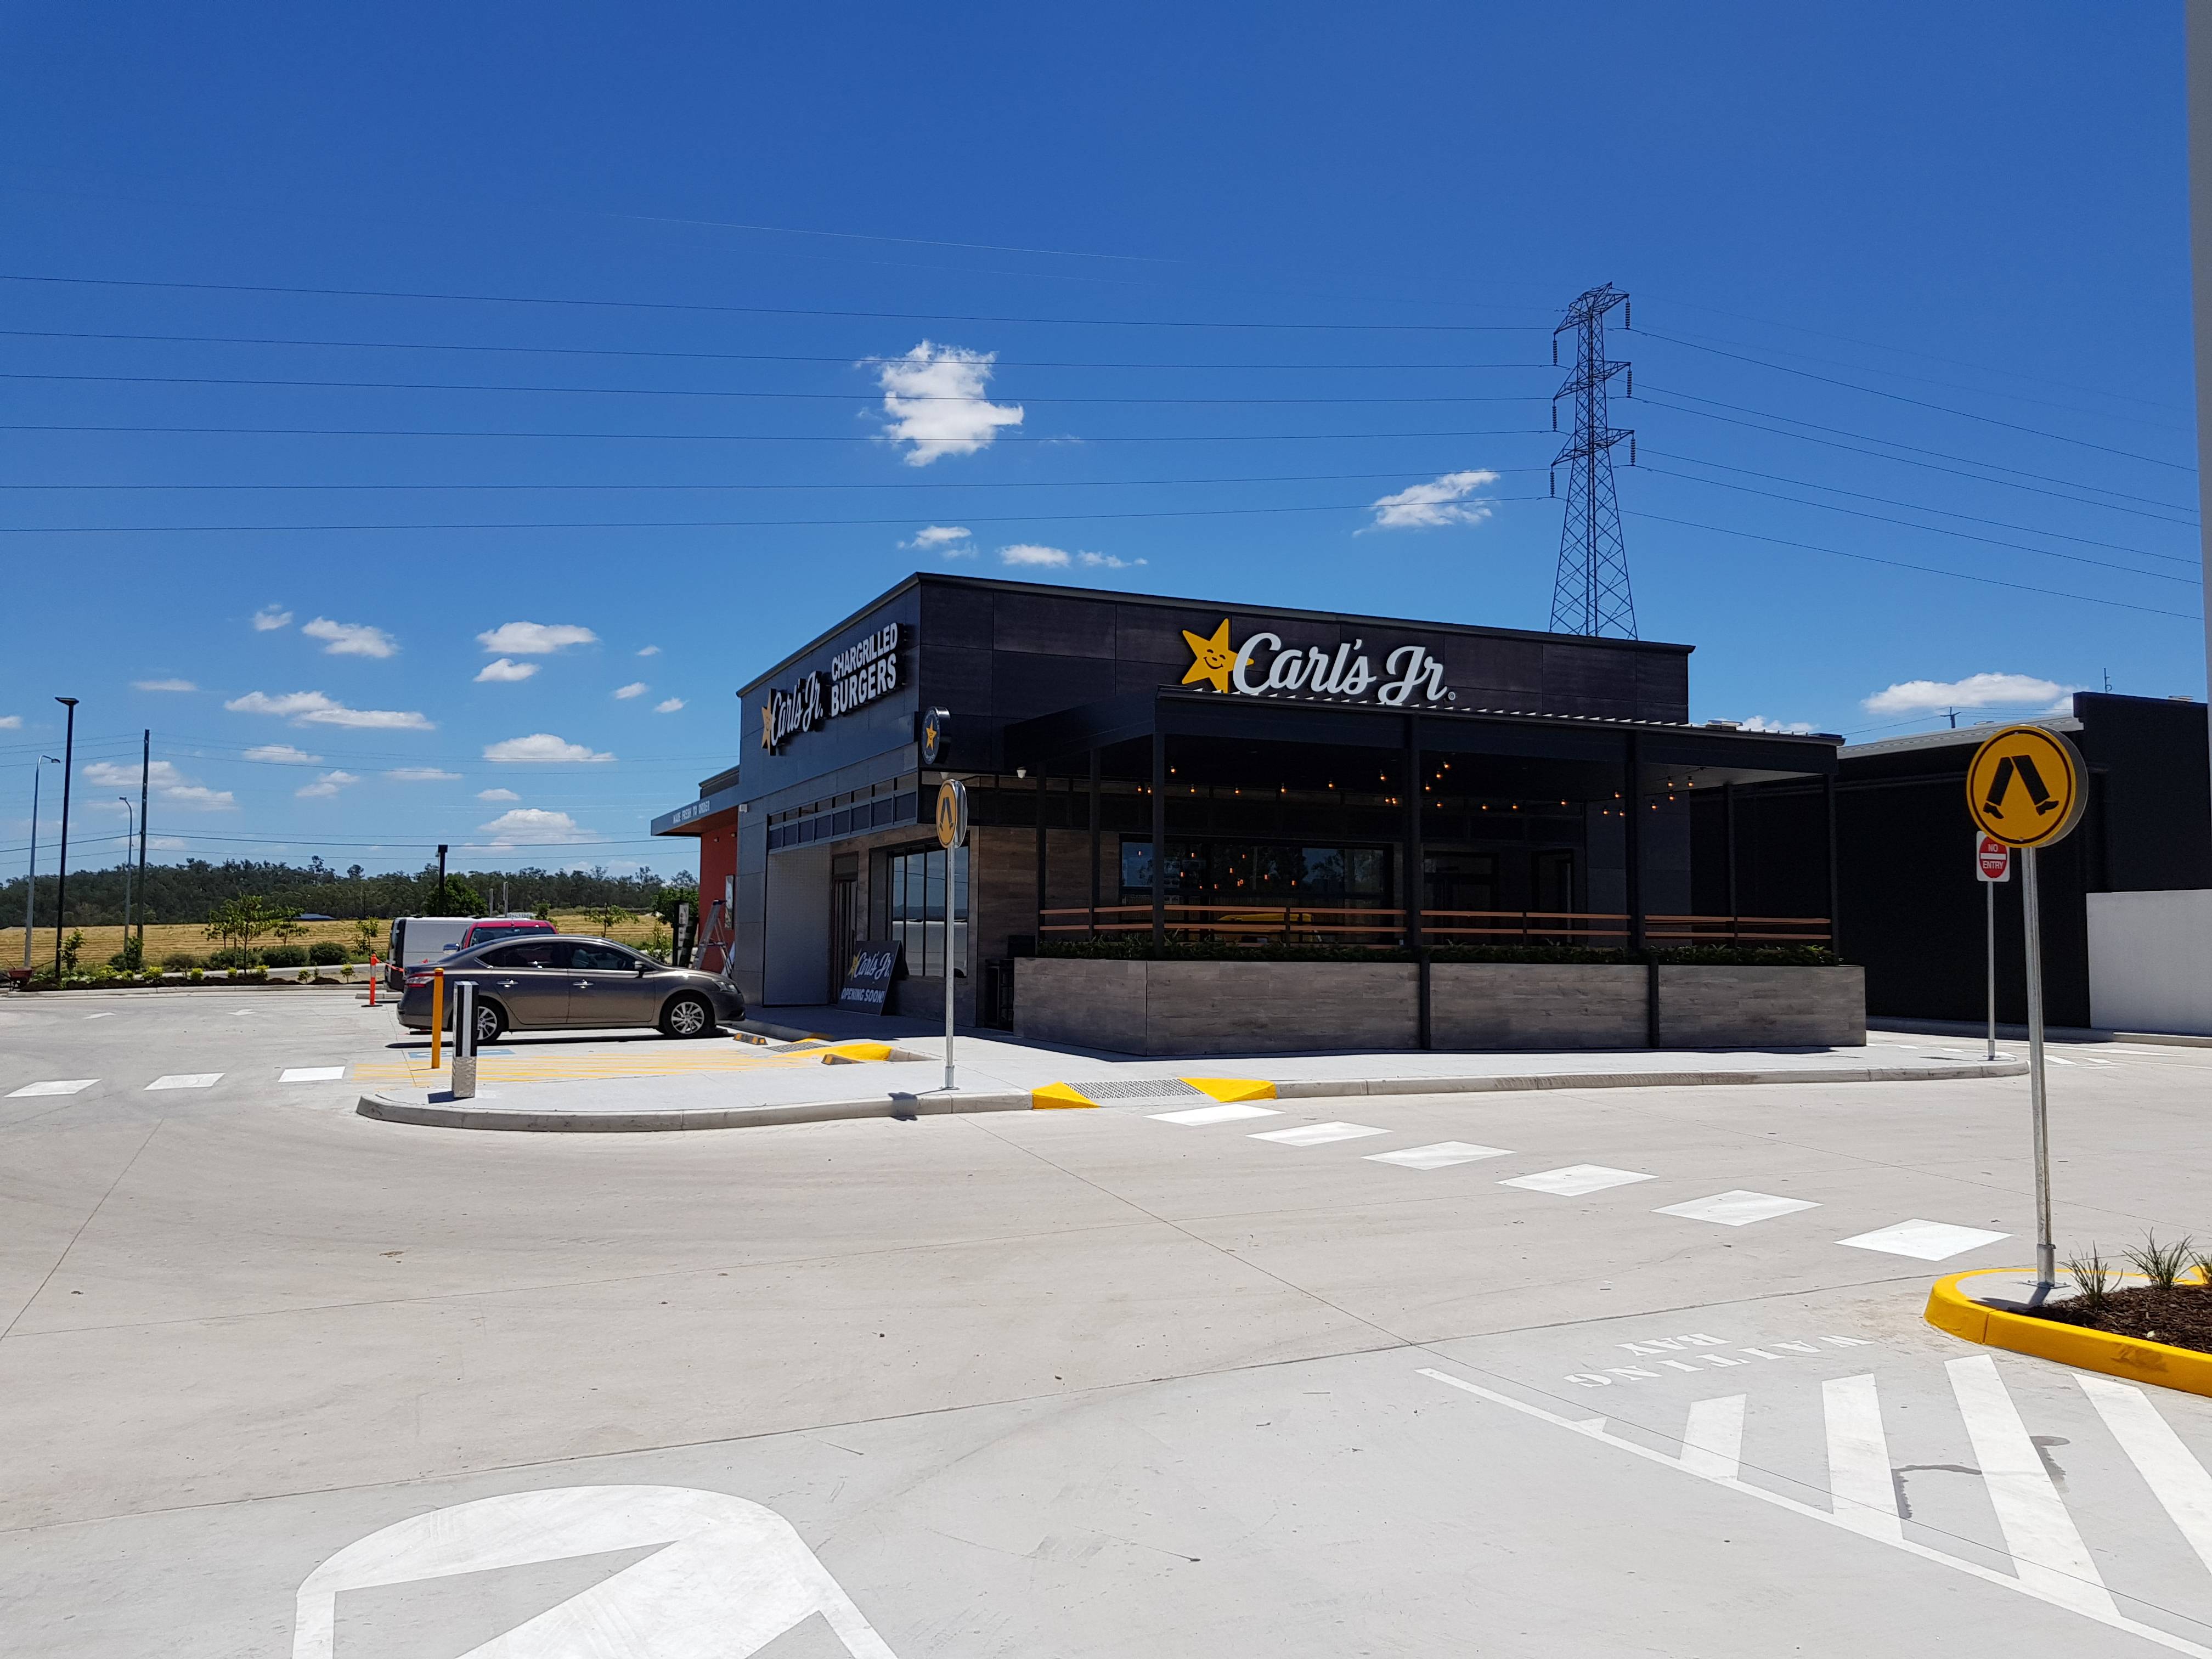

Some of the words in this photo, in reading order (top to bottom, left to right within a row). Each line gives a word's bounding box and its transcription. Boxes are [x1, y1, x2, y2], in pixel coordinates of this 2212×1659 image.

[832, 622, 898, 681] CHARGRILLED
[1233, 633, 1377, 695] Carl's
[831, 653, 896, 717] BURGERS
[771, 678, 803, 746] Carl's
[673, 812, 681, 824] MADE
[682, 808, 692, 821] FRESH
[693, 805, 698, 817] TO
[698, 800, 710, 814] ORDER
[1988, 844, 1999, 852] NO
[1983, 860, 2004, 869] ENTRY
[854, 951, 880, 978] Carl's
[840, 988, 865, 1001] OPENING
[864, 989, 885, 1003] SOON!
[1615, 1333, 1732, 1356] BAY
[1562, 1335, 1875, 1388] WAITING
